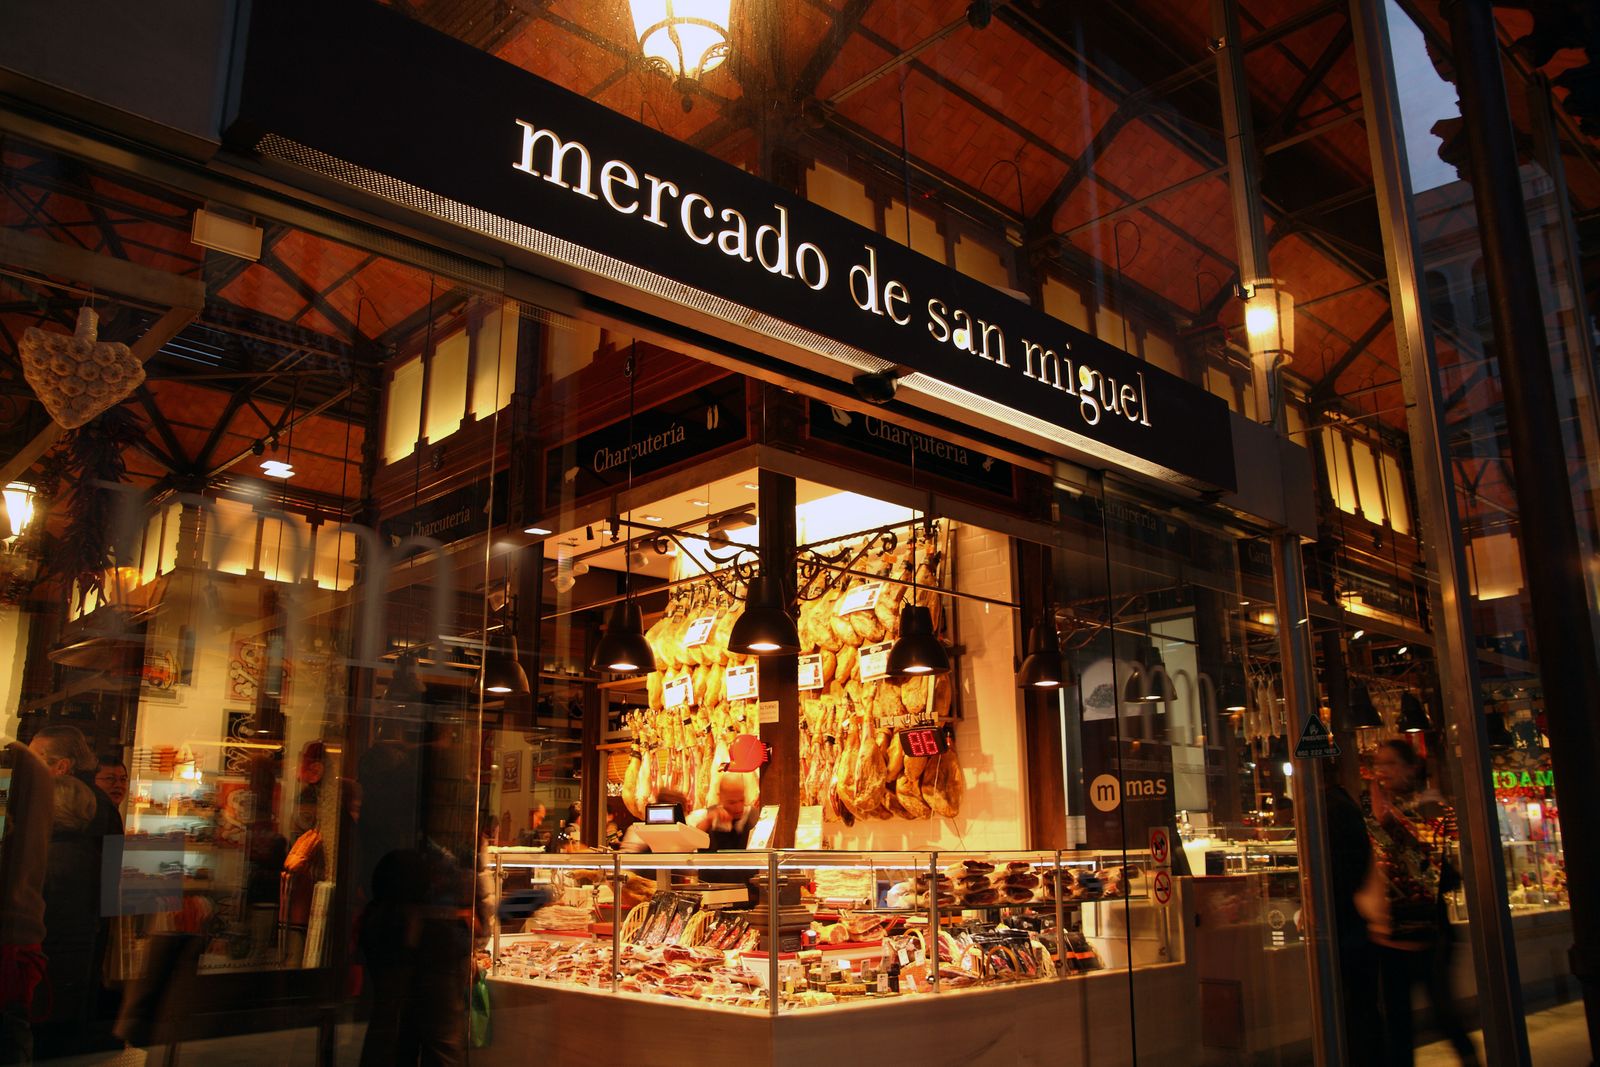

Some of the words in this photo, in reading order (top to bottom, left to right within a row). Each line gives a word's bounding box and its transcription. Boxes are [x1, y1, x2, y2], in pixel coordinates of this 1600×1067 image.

[512, 118, 829, 290] mercado
[849, 244, 911, 326] de
[927, 298, 1011, 368] san
[1021, 342, 1152, 427] miguel
[593, 421, 686, 473] Charcutería
[1125, 778, 1167, 797] mas
